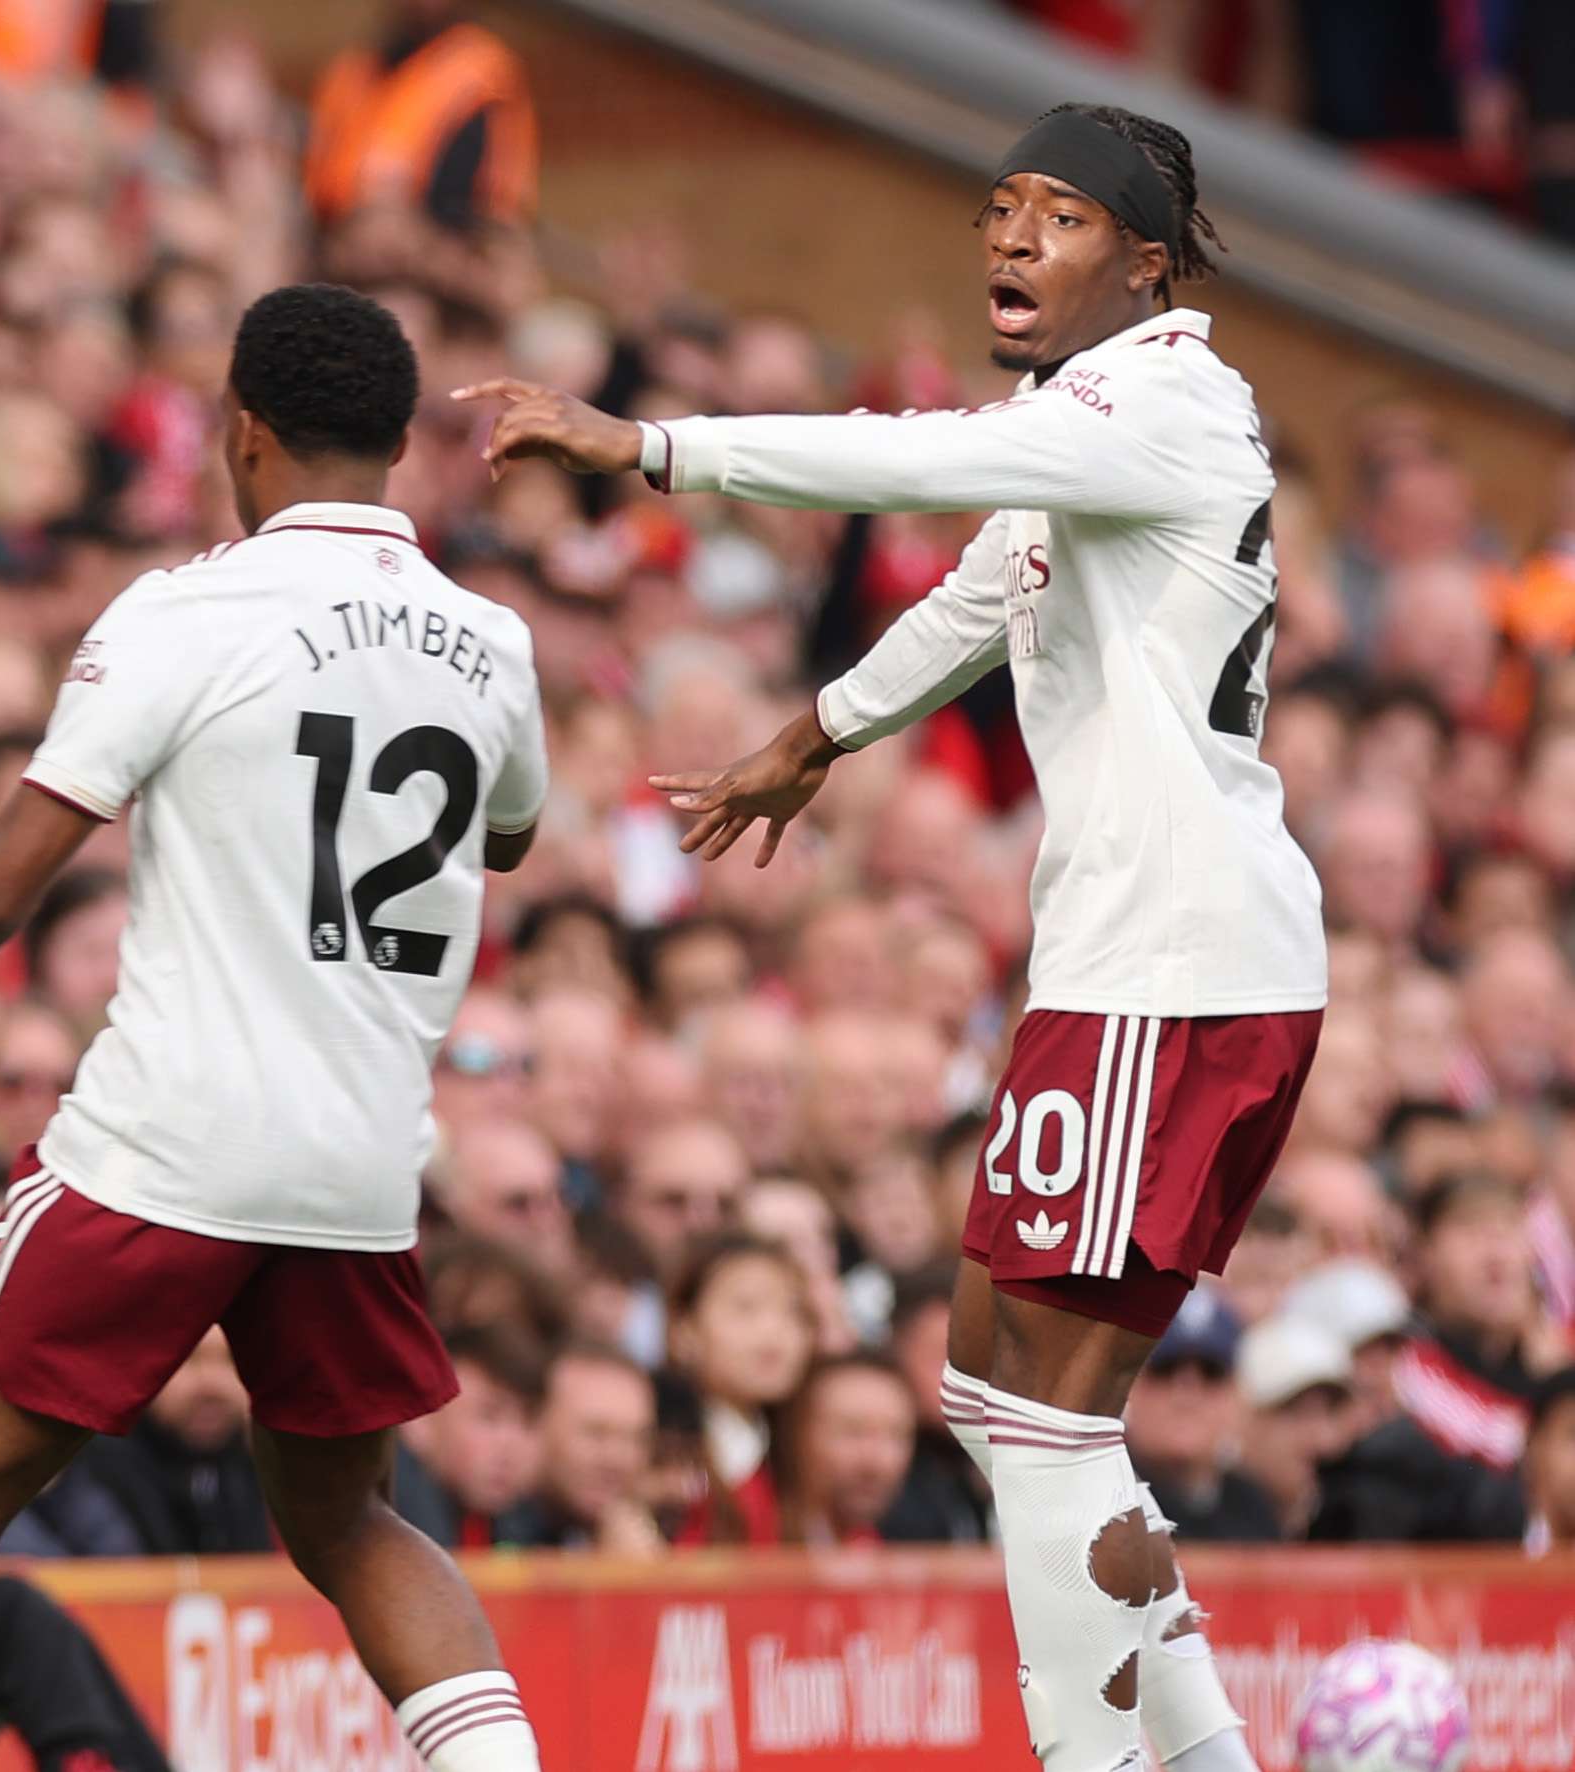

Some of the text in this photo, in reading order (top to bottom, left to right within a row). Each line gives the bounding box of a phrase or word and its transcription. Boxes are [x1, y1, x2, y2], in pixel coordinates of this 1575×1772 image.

[1041, 379, 1114, 417] ANDA
[1065, 368, 1111, 386] SIT
[293, 710, 479, 978] 12
[986, 1089, 1086, 1197] 20
